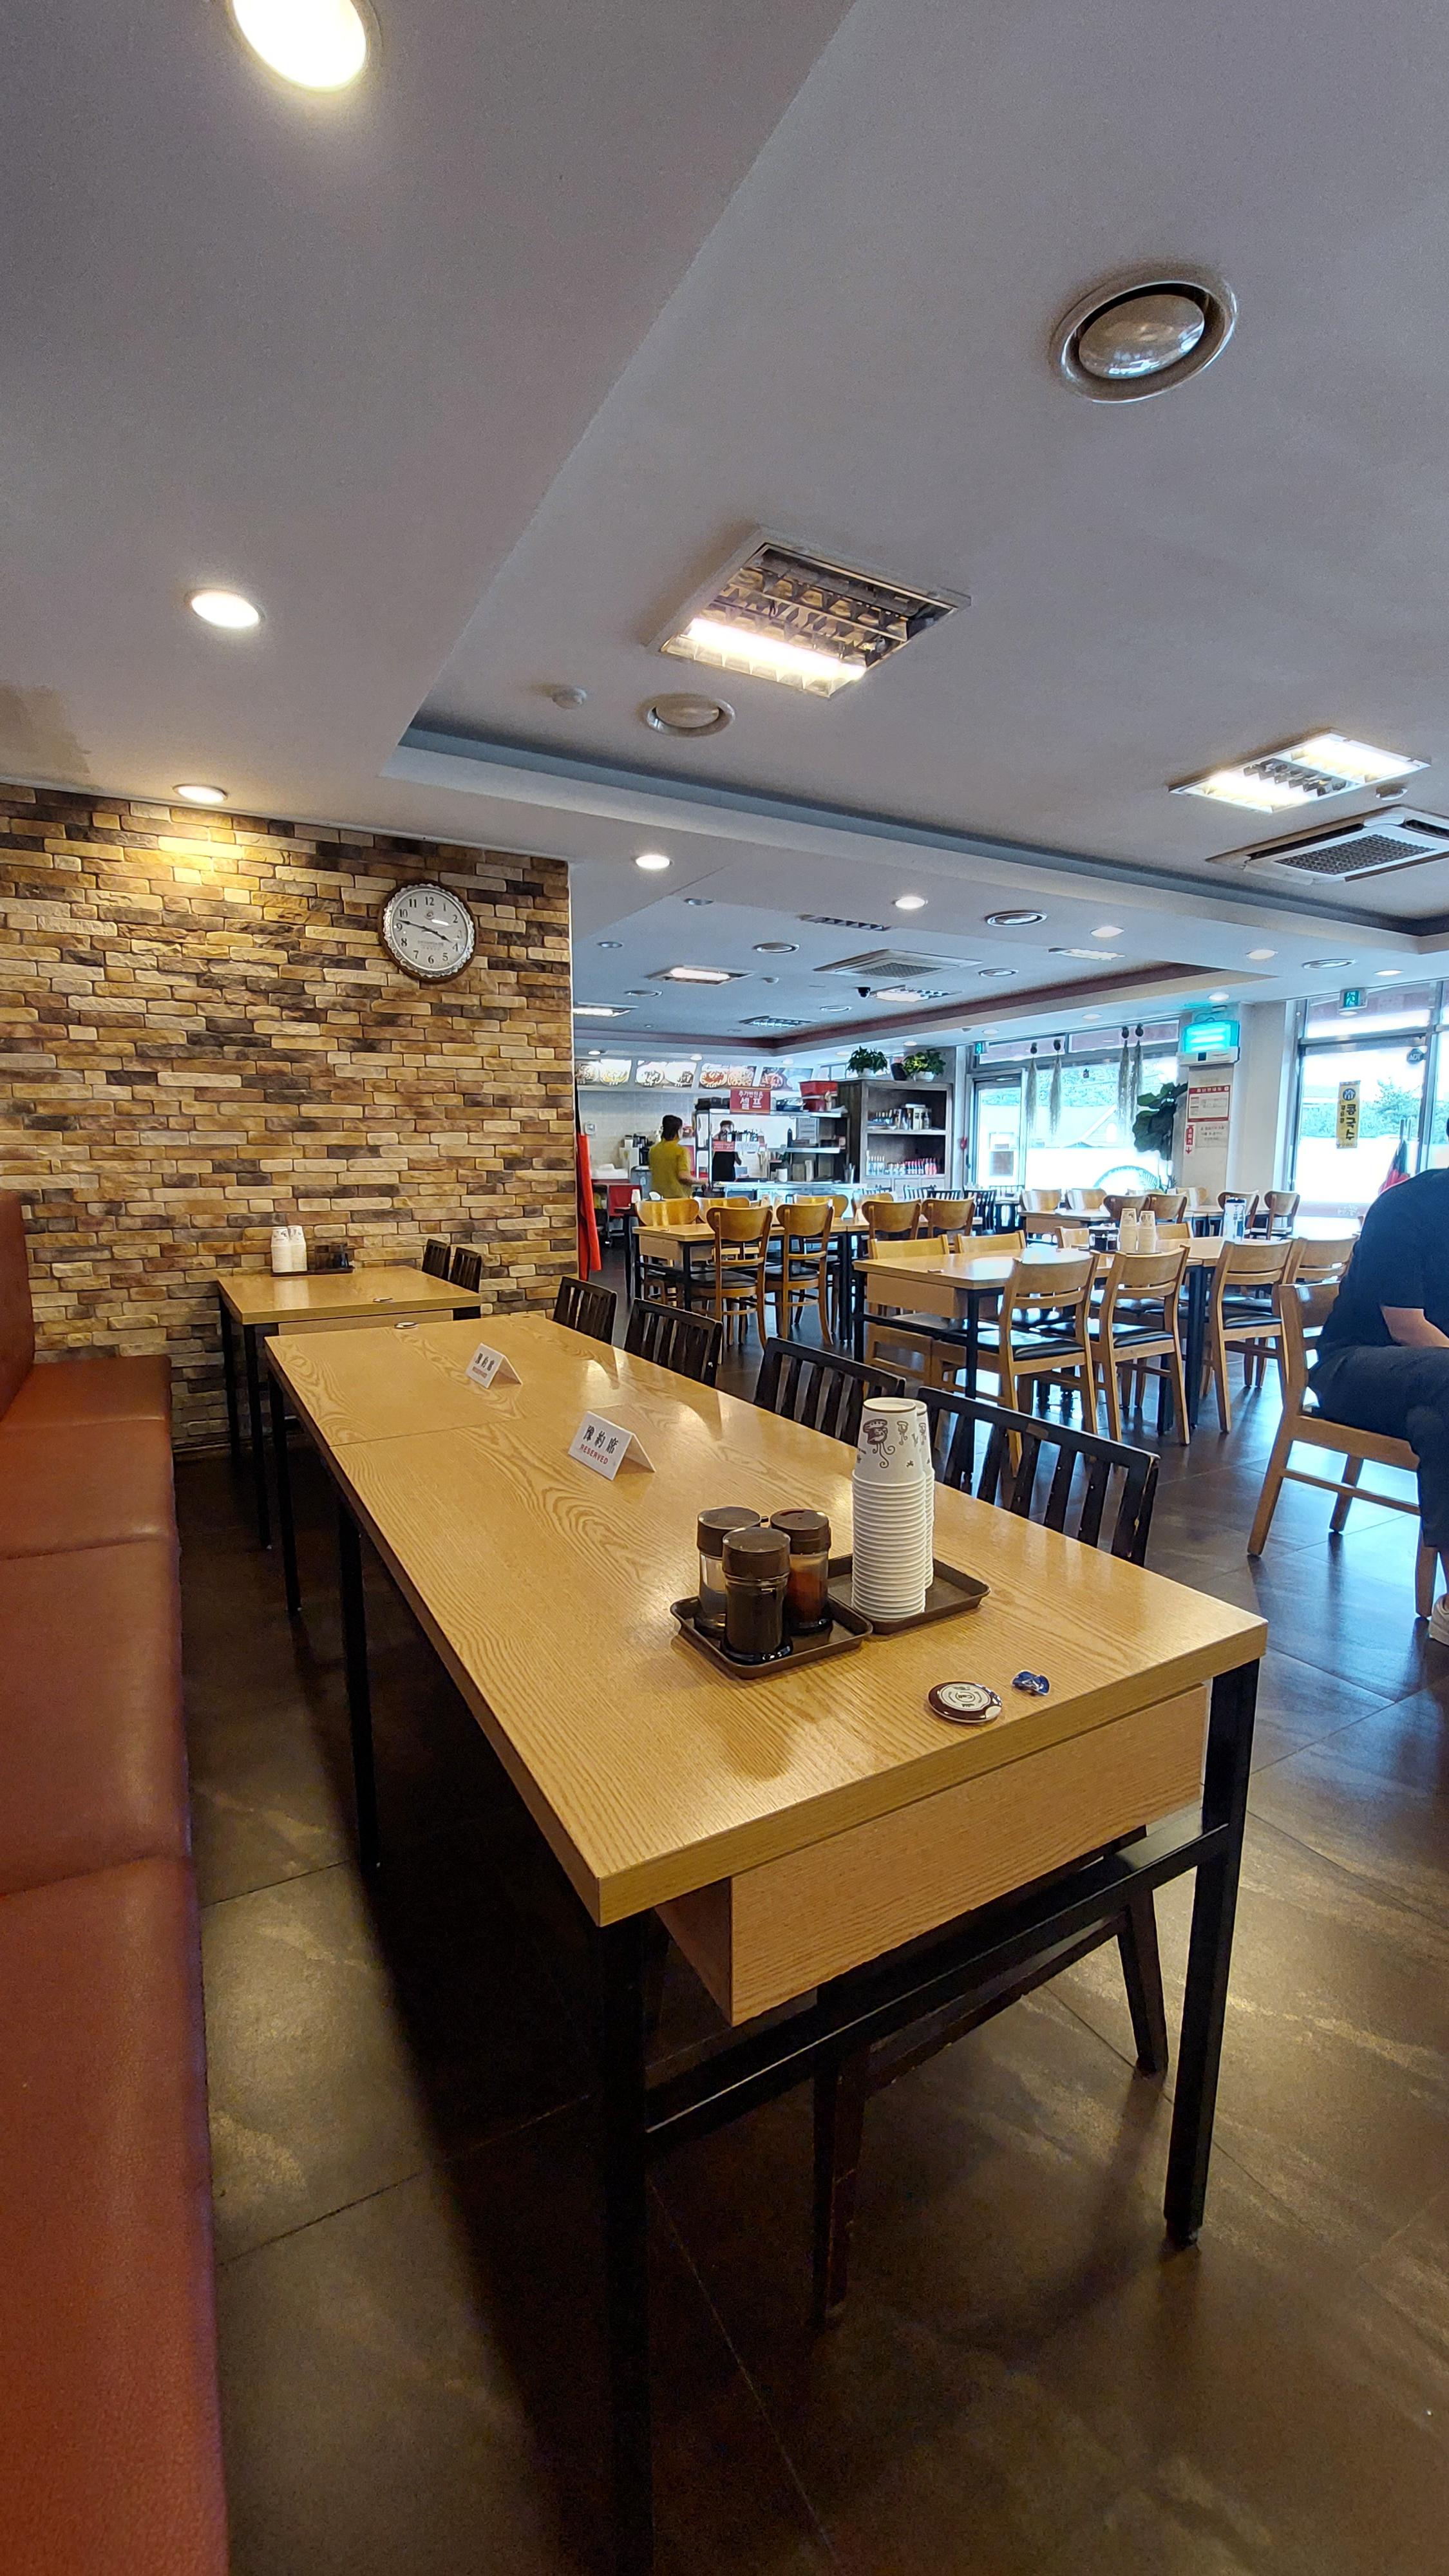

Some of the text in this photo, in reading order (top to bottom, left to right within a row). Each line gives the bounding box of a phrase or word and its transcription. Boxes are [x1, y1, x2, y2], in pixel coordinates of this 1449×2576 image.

[409, 898, 417, 907] 11
[425, 896, 435, 906] 12
[399, 909, 408, 918] 10
[453, 914, 458, 923] 2
[396, 922, 402, 931] 9
[401, 938, 408, 947] 8
[413, 950, 419, 959] 7
[442, 952, 448, 961] 5
[428, 955, 434, 964] 6
[740, 1097, 762, 1110] 셀프
[1346, 1104, 1357, 1141] 콩국수
[579, 1444, 609, 1464] RESERVED
